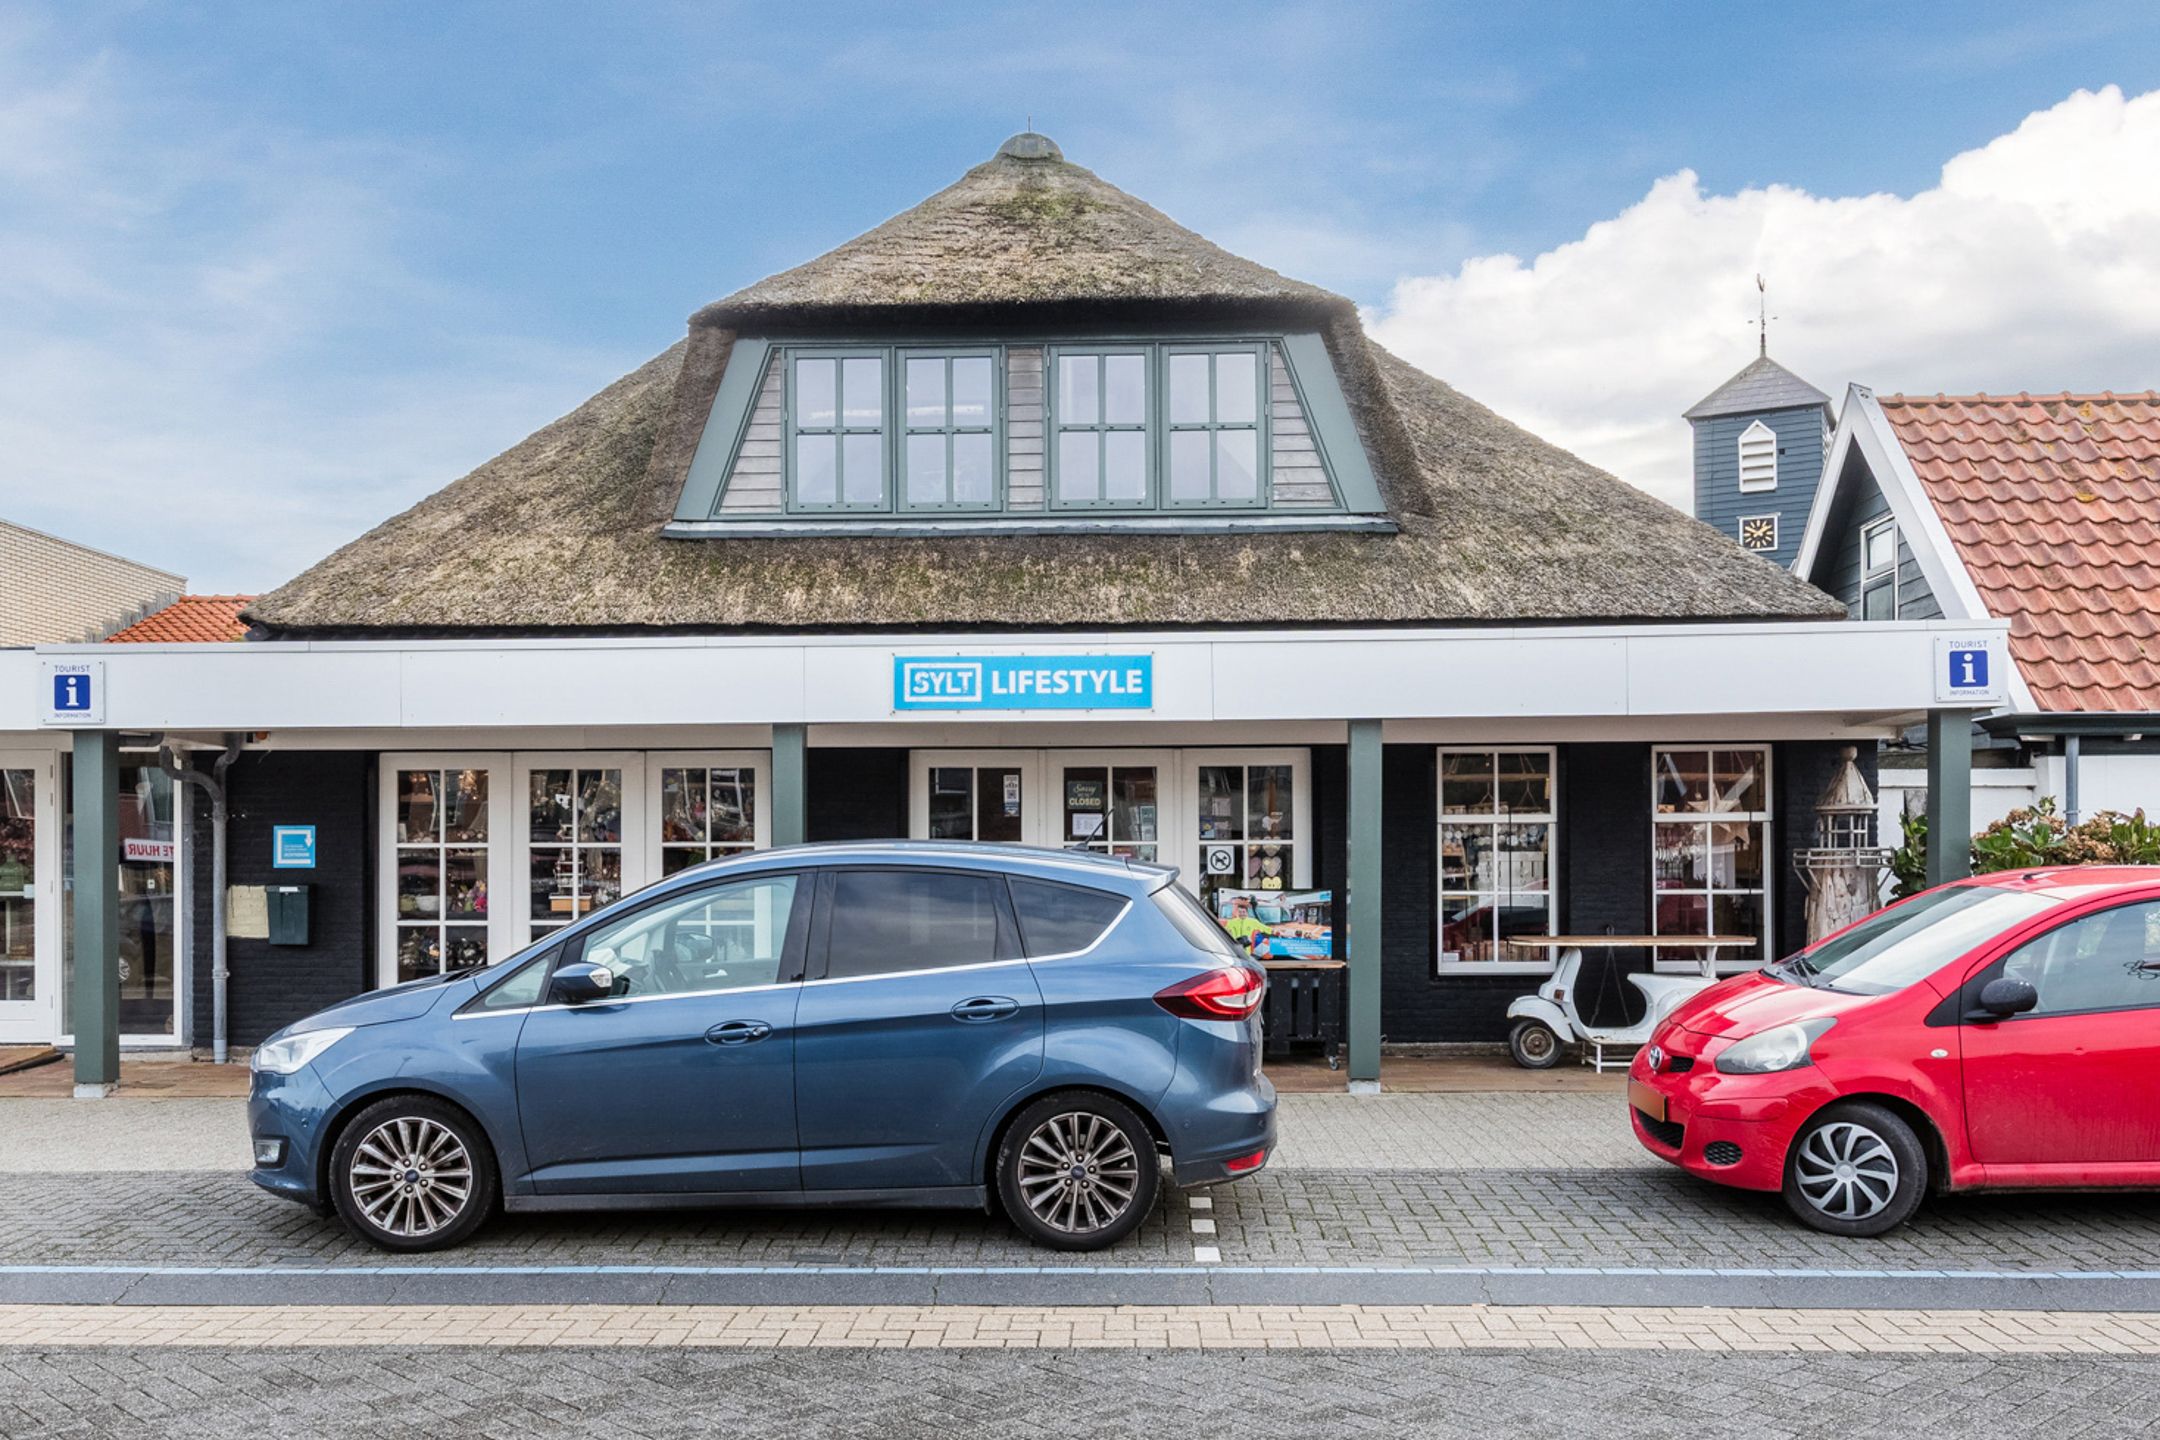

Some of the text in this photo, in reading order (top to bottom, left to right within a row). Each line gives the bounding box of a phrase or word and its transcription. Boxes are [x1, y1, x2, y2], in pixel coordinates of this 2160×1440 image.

[1949, 640, 1987, 648] TOURIST
[54, 664, 90, 673] TOURIST
[912, 669, 1143, 694] SYLT LIFESTYLE
[1069, 797, 1101, 806] CLOSED
